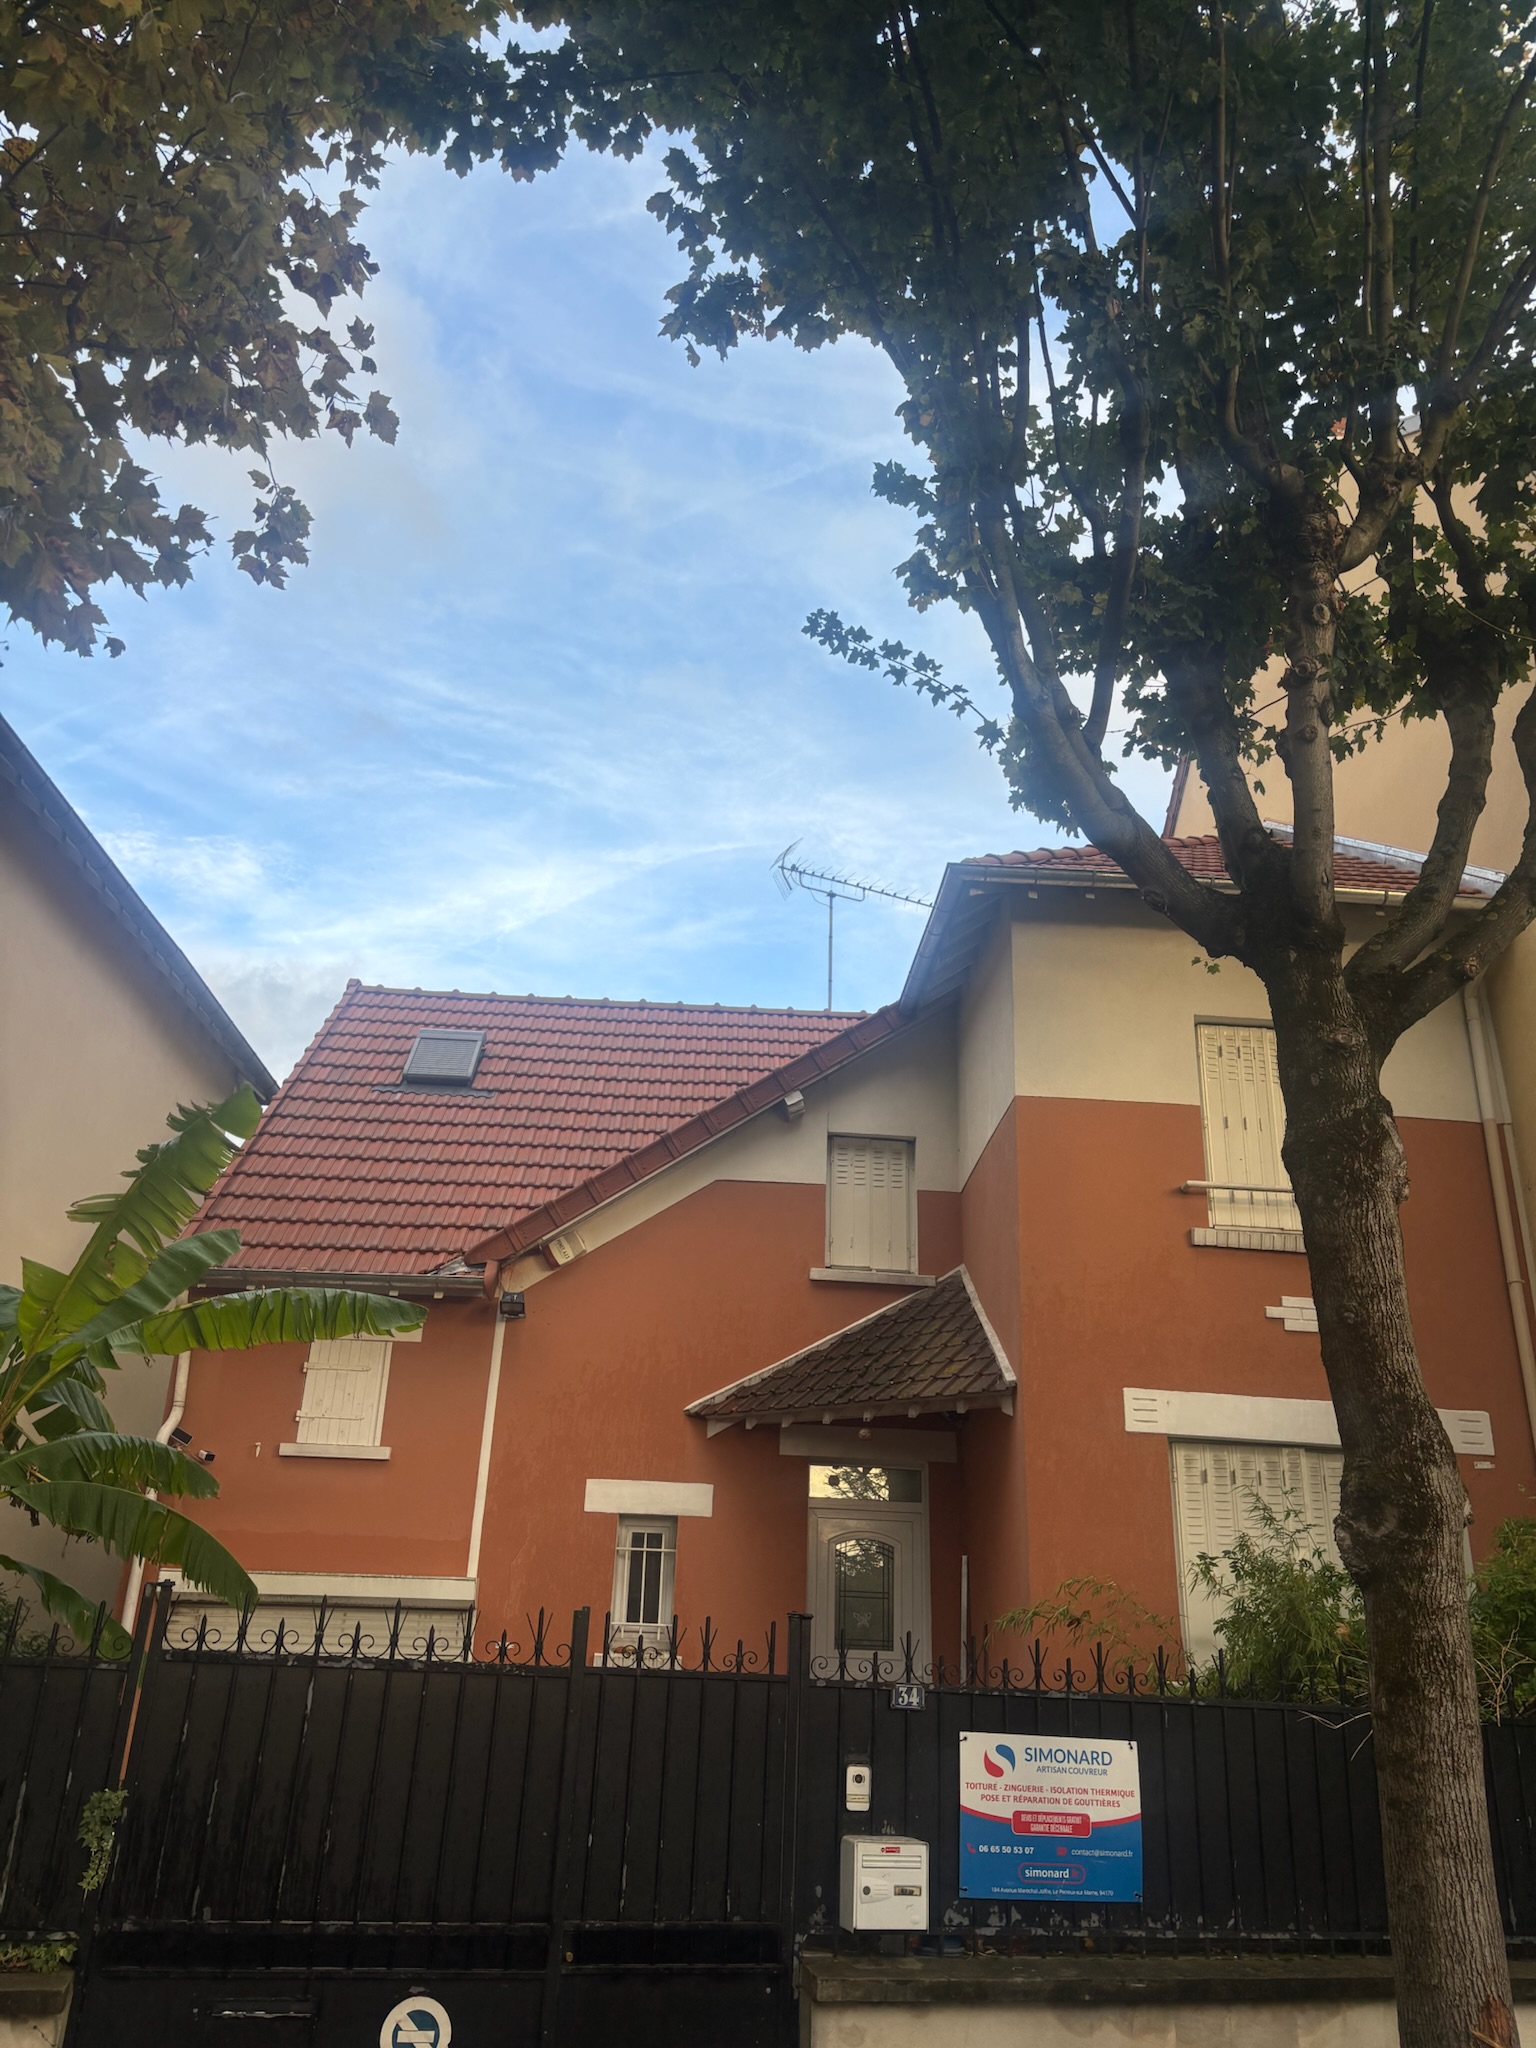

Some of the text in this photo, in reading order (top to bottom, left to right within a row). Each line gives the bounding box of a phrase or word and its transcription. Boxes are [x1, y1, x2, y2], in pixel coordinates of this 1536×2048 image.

[898, 1686, 920, 1706] 34
[1024, 1747, 1112, 1766] SIMONARD
[1036, 1766, 1108, 1776] ARTISAN COUVREUR
[1004, 1784, 1044, 1793] ZINGUERIE
[1050, 1786, 1089, 1795] ISOLATION
[1090, 1788, 1135, 1798] THERMIQUE
[980, 1794, 1000, 1802] POSE
[1013, 1794, 1061, 1805] RÉPARATION
[1074, 1797, 1121, 1808] GOUTTIÈRES
[1071, 1848, 1133, 1857] contact@simonard.fr
